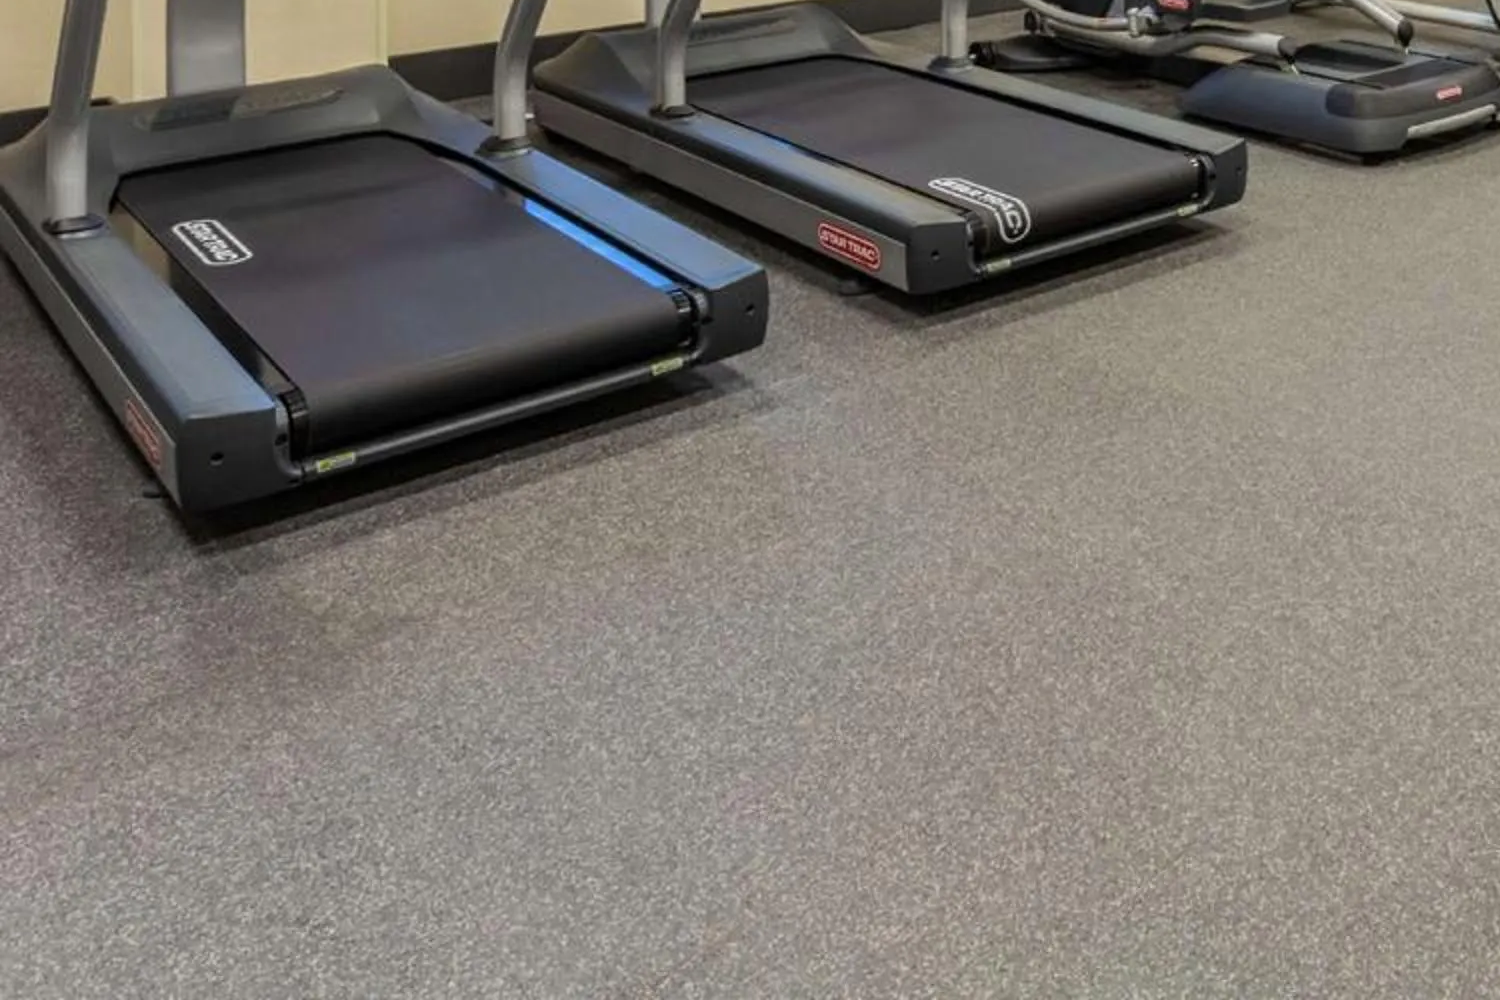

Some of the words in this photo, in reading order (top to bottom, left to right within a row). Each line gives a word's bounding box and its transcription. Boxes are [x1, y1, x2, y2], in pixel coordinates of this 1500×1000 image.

[203, 240, 239, 261] TRAC
[820, 230, 847, 249] STAR
[848, 241, 876, 261] TRAC
